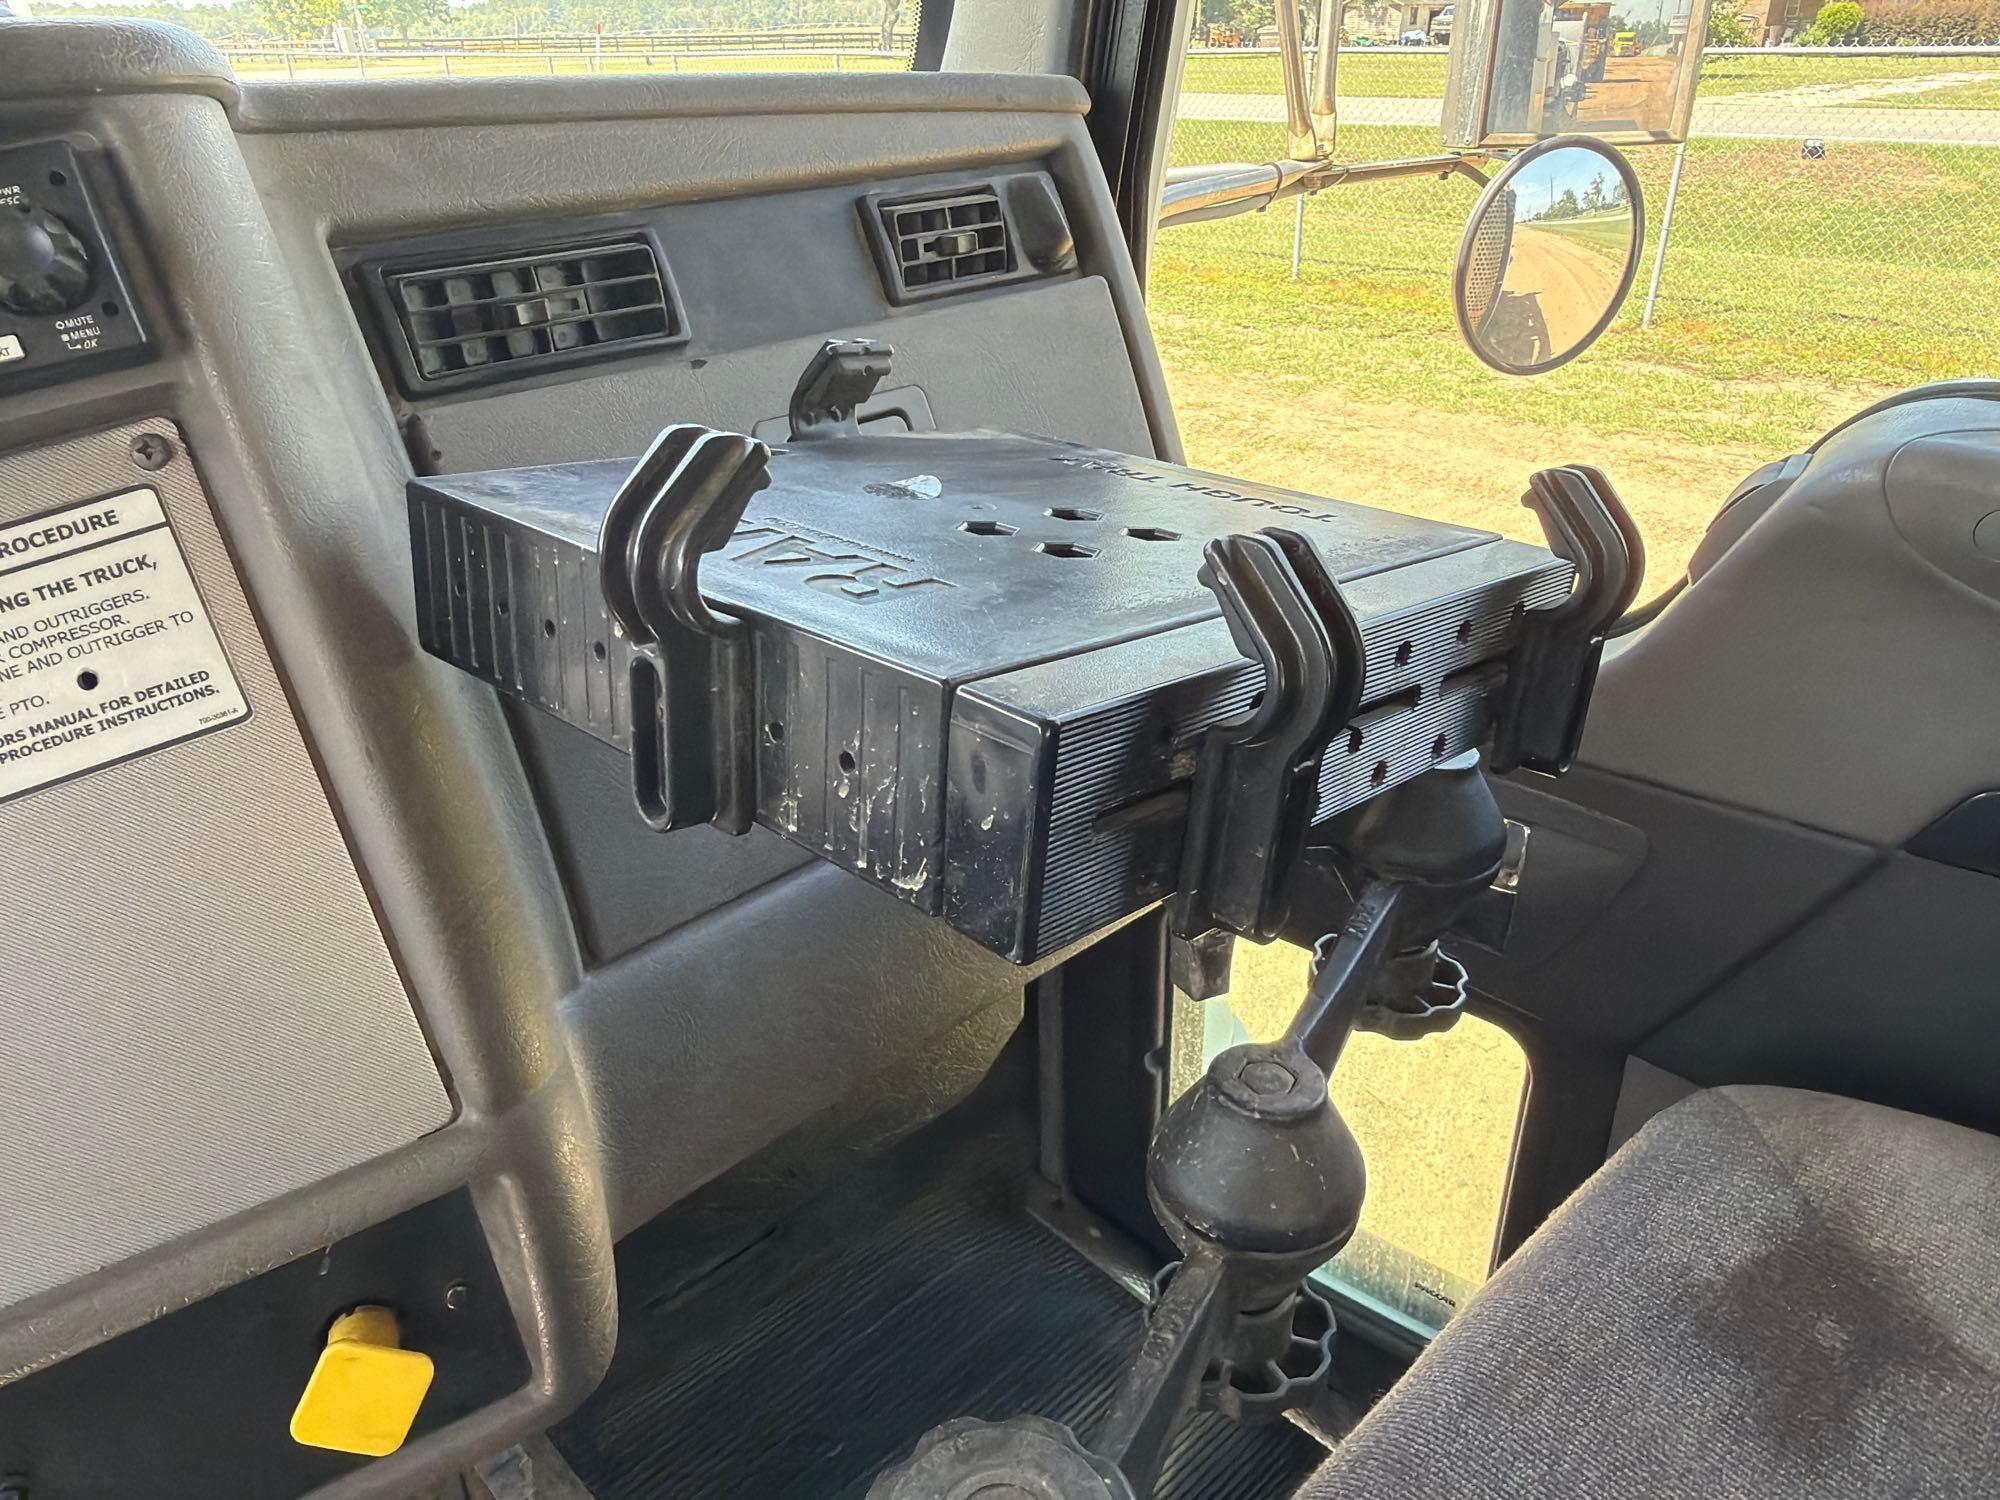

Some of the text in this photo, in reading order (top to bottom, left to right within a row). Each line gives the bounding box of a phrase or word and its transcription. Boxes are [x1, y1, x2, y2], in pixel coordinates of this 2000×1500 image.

[65, 315, 95, 328] MUTE
[70, 326, 101, 340] MENU
[83, 338, 98, 349] OK
[1169, 482, 1338, 523] TOUGH
[32, 577, 78, 601] THE
[79, 554, 157, 587] TRUCK,
[34, 589, 150, 632] OUTRIGGERS.
[9, 614, 130, 659] COMPRESSOR.
[27, 652, 63, 673] AND
[67, 619, 168, 659] OUTRIGGER
[169, 610, 194, 627] TO
[9, 695, 50, 715] PTO.
[29, 707, 98, 737] MANUAL
[99, 696, 133, 714] FOR
[134, 670, 210, 702] DETAILED
[97, 684, 220, 731] INSTRUCTIONS.
